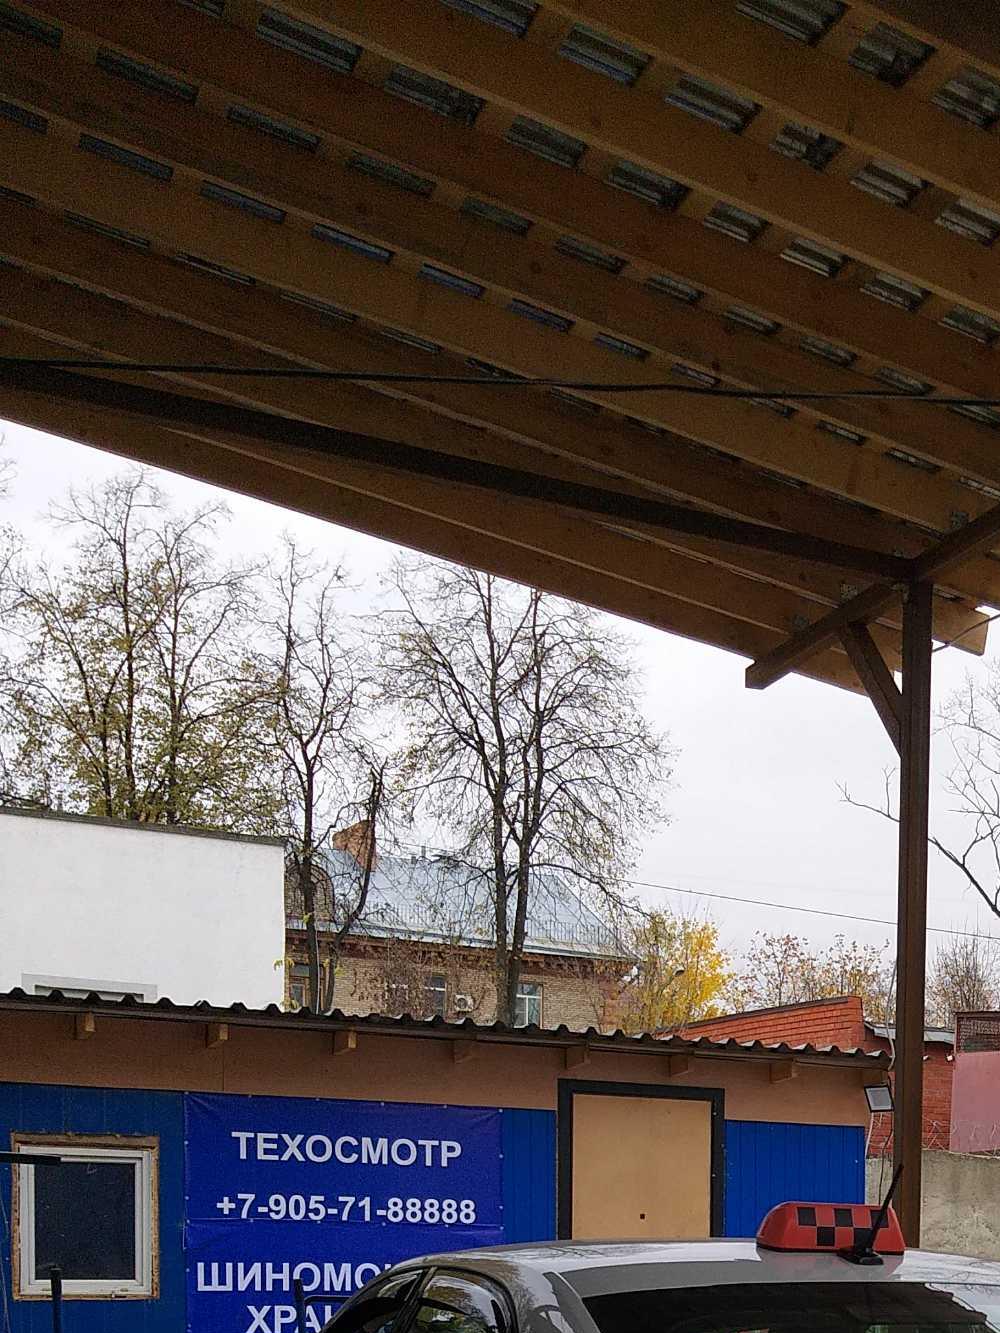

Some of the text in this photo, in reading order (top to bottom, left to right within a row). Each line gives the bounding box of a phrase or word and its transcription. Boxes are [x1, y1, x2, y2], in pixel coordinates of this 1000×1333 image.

[232, 1132, 462, 1167] ТЕХОСМОТР
[216, 1193, 477, 1224] +7-905-71-88888
[197, 1262, 391, 1292] ШИНОМО
